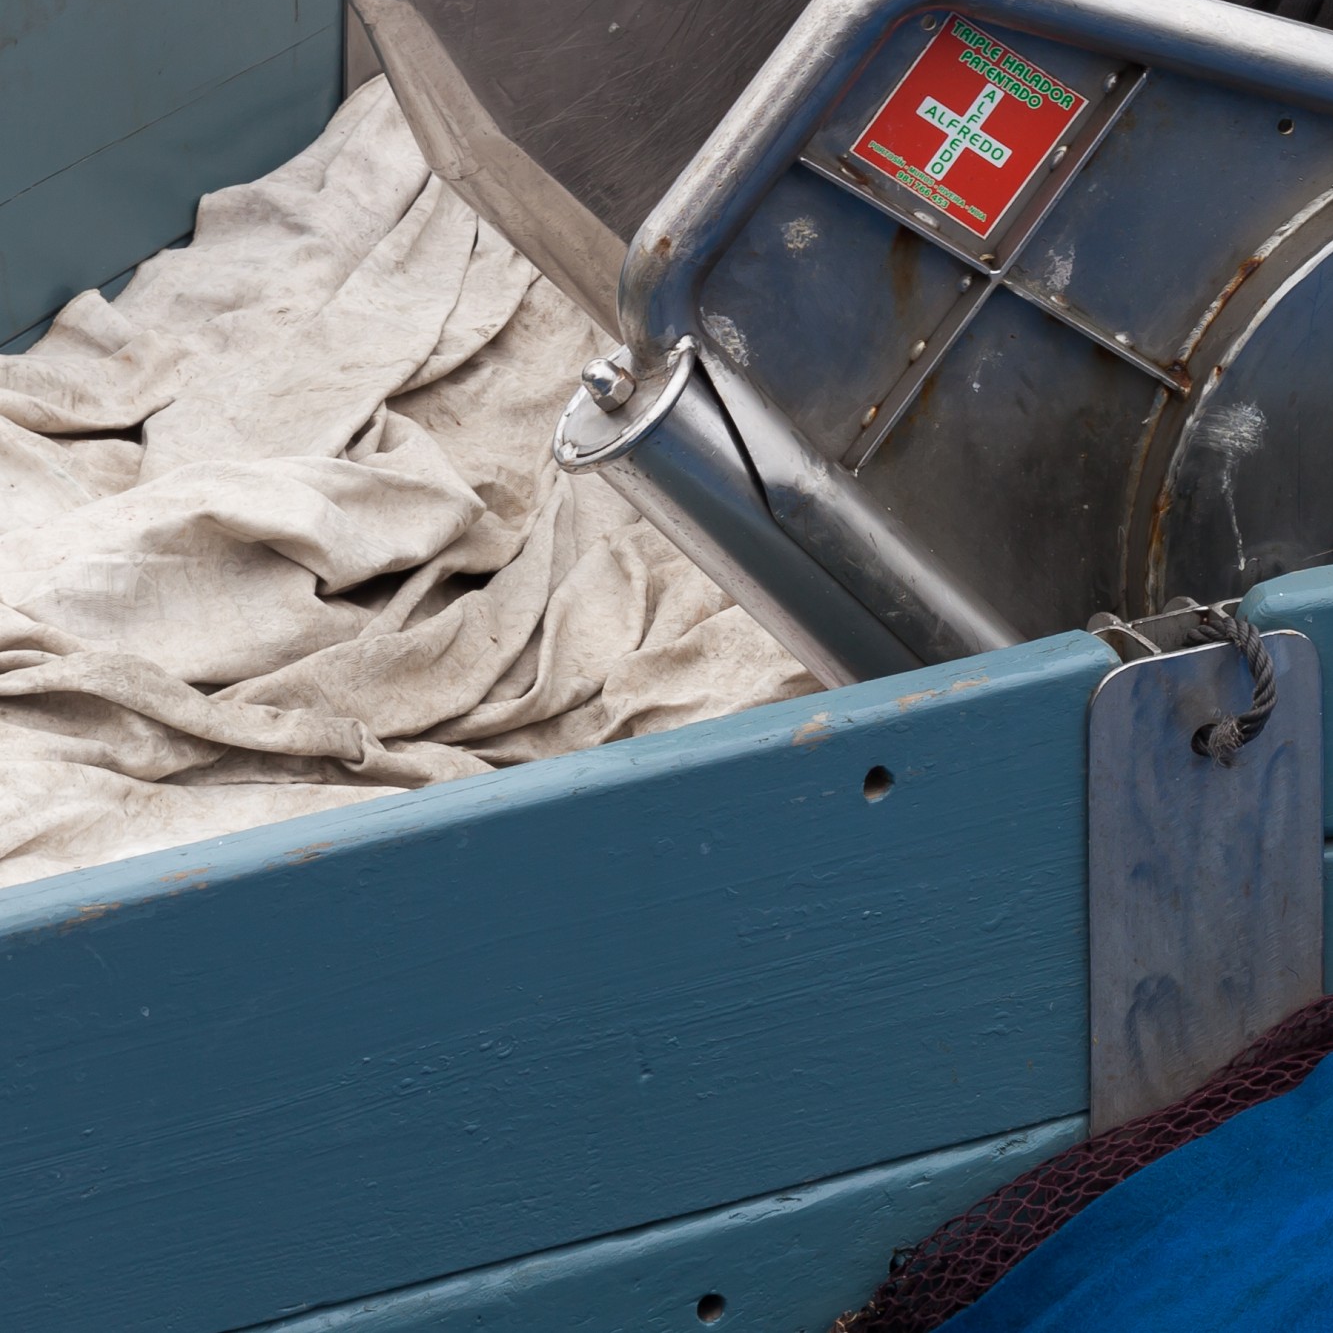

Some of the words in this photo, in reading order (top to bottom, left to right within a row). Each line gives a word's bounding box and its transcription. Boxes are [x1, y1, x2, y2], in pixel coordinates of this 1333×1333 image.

[951, 19, 1004, 62] TRIPLE
[1000, 54, 1075, 111] HALADOR
[958, 49, 1042, 109] PATENTADO
[924, 106, 1004, 161] ALFREDO
[931, 90, 996, 174] ALFREDO
[896, 170, 915, 186] 981
[912, 180, 932, 195] 766
[930, 193, 950, 209] 453
[907, 165, 936, 187] MUROS
